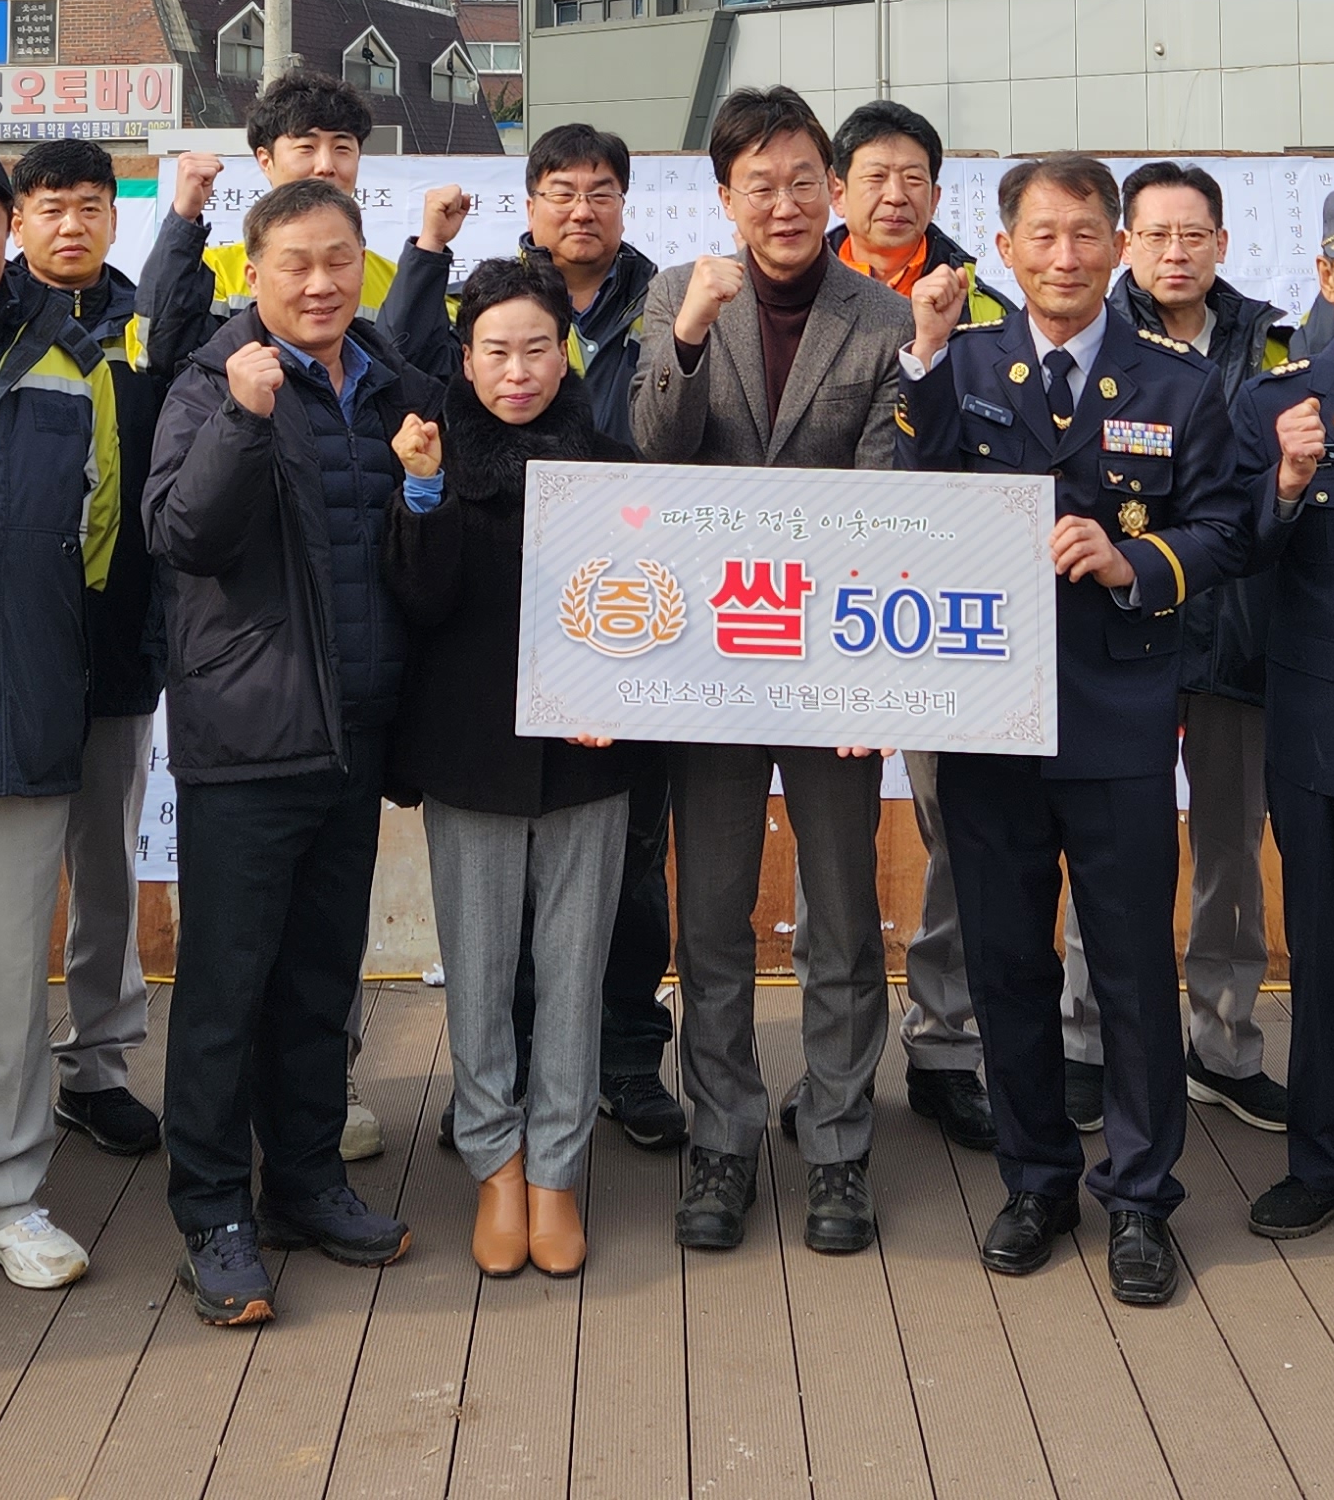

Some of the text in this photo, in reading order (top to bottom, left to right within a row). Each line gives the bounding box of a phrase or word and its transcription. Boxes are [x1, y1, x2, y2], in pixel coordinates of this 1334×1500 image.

[661, 506, 747, 533] 따뜻한
[757, 507, 811, 540] 정을
[594, 578, 652, 638] 증
[707, 559, 1011, 658] 쌀 50포
[616, 678, 957, 716] 안산소방소 반월의용소방대
